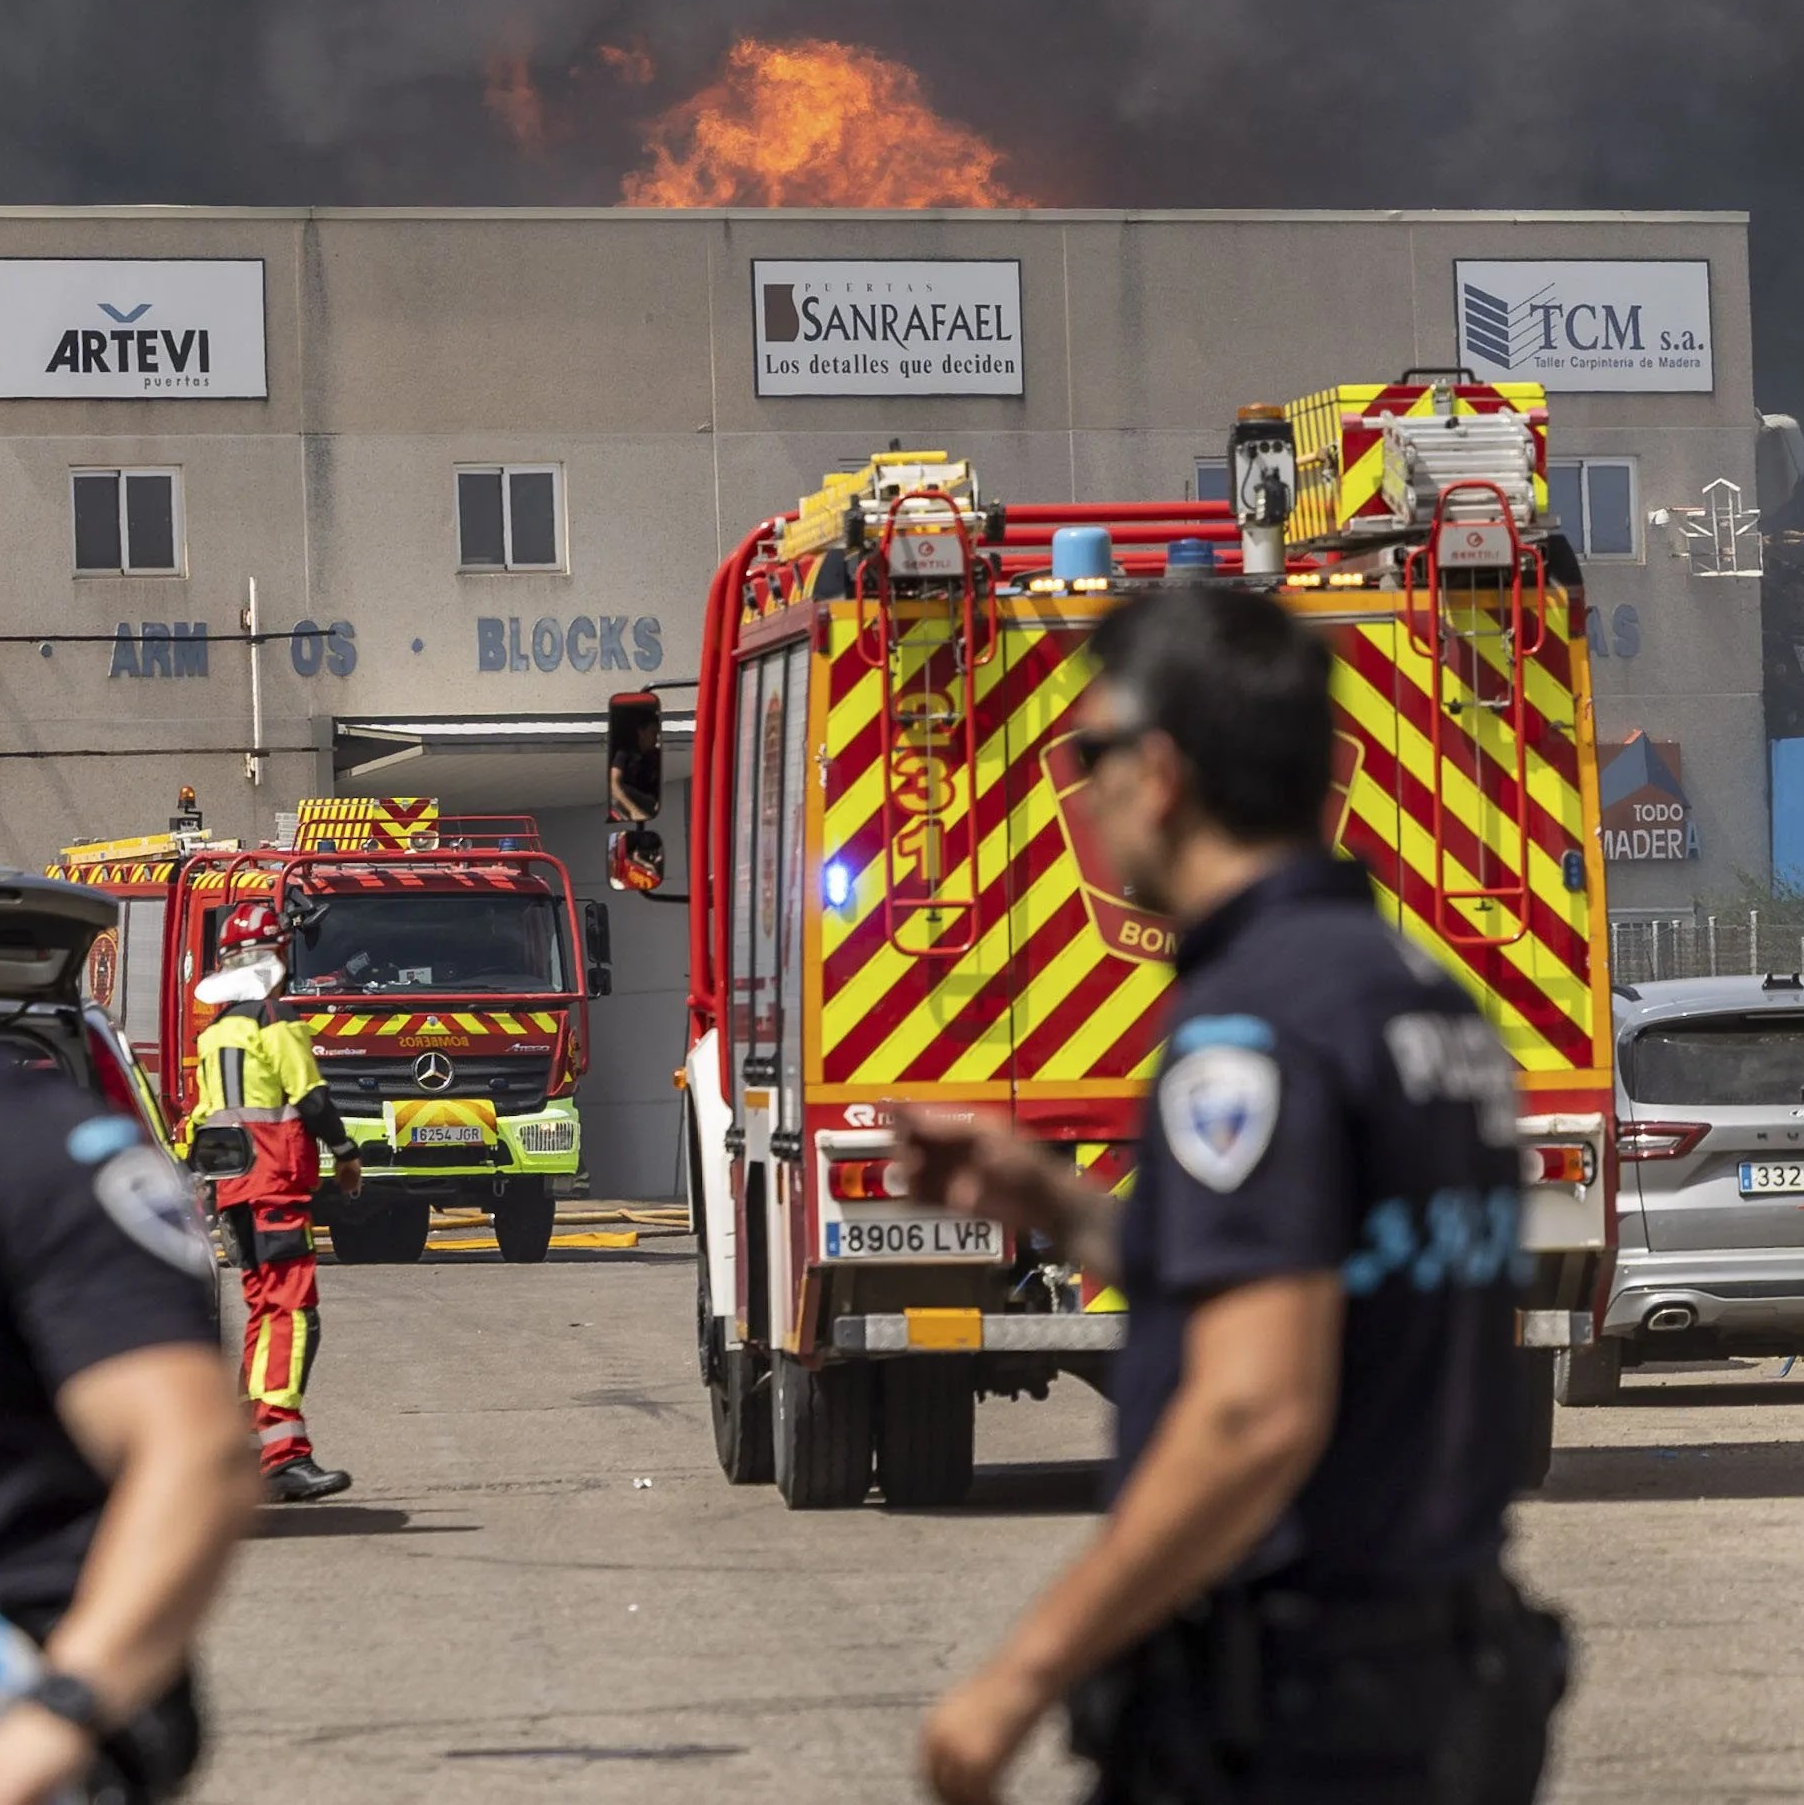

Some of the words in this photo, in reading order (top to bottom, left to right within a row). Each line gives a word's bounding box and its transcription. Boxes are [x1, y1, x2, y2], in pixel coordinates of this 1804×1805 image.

[804, 282, 934, 293] PUERTAS
[801, 296, 1013, 351] SANRAFAEL
[1529, 302, 1646, 351] TCM
[1660, 329, 1705, 351] s.a.
[45, 329, 210, 373] ARTEVI
[1534, 355, 1566, 369] Taller
[1639, 355, 1654, 369] de
[1658, 355, 1702, 369] Madera
[765, 353, 800, 374] Los
[809, 353, 890, 374] detalles
[899, 358, 933, 378] que
[942, 353, 1016, 374] deciden
[144, 374, 211, 390] puertas
[108, 621, 209, 678] ARM
[289, 619, 358, 677] OS
[476, 615, 664, 673] BLOCKS
[1633, 803, 1683, 822] TODO
[419, 1127, 452, 1142] 6254
[456, 1127, 480, 1141] JGR
[847, 1224, 925, 1253] 8906
[933, 1221, 992, 1252] LVR
